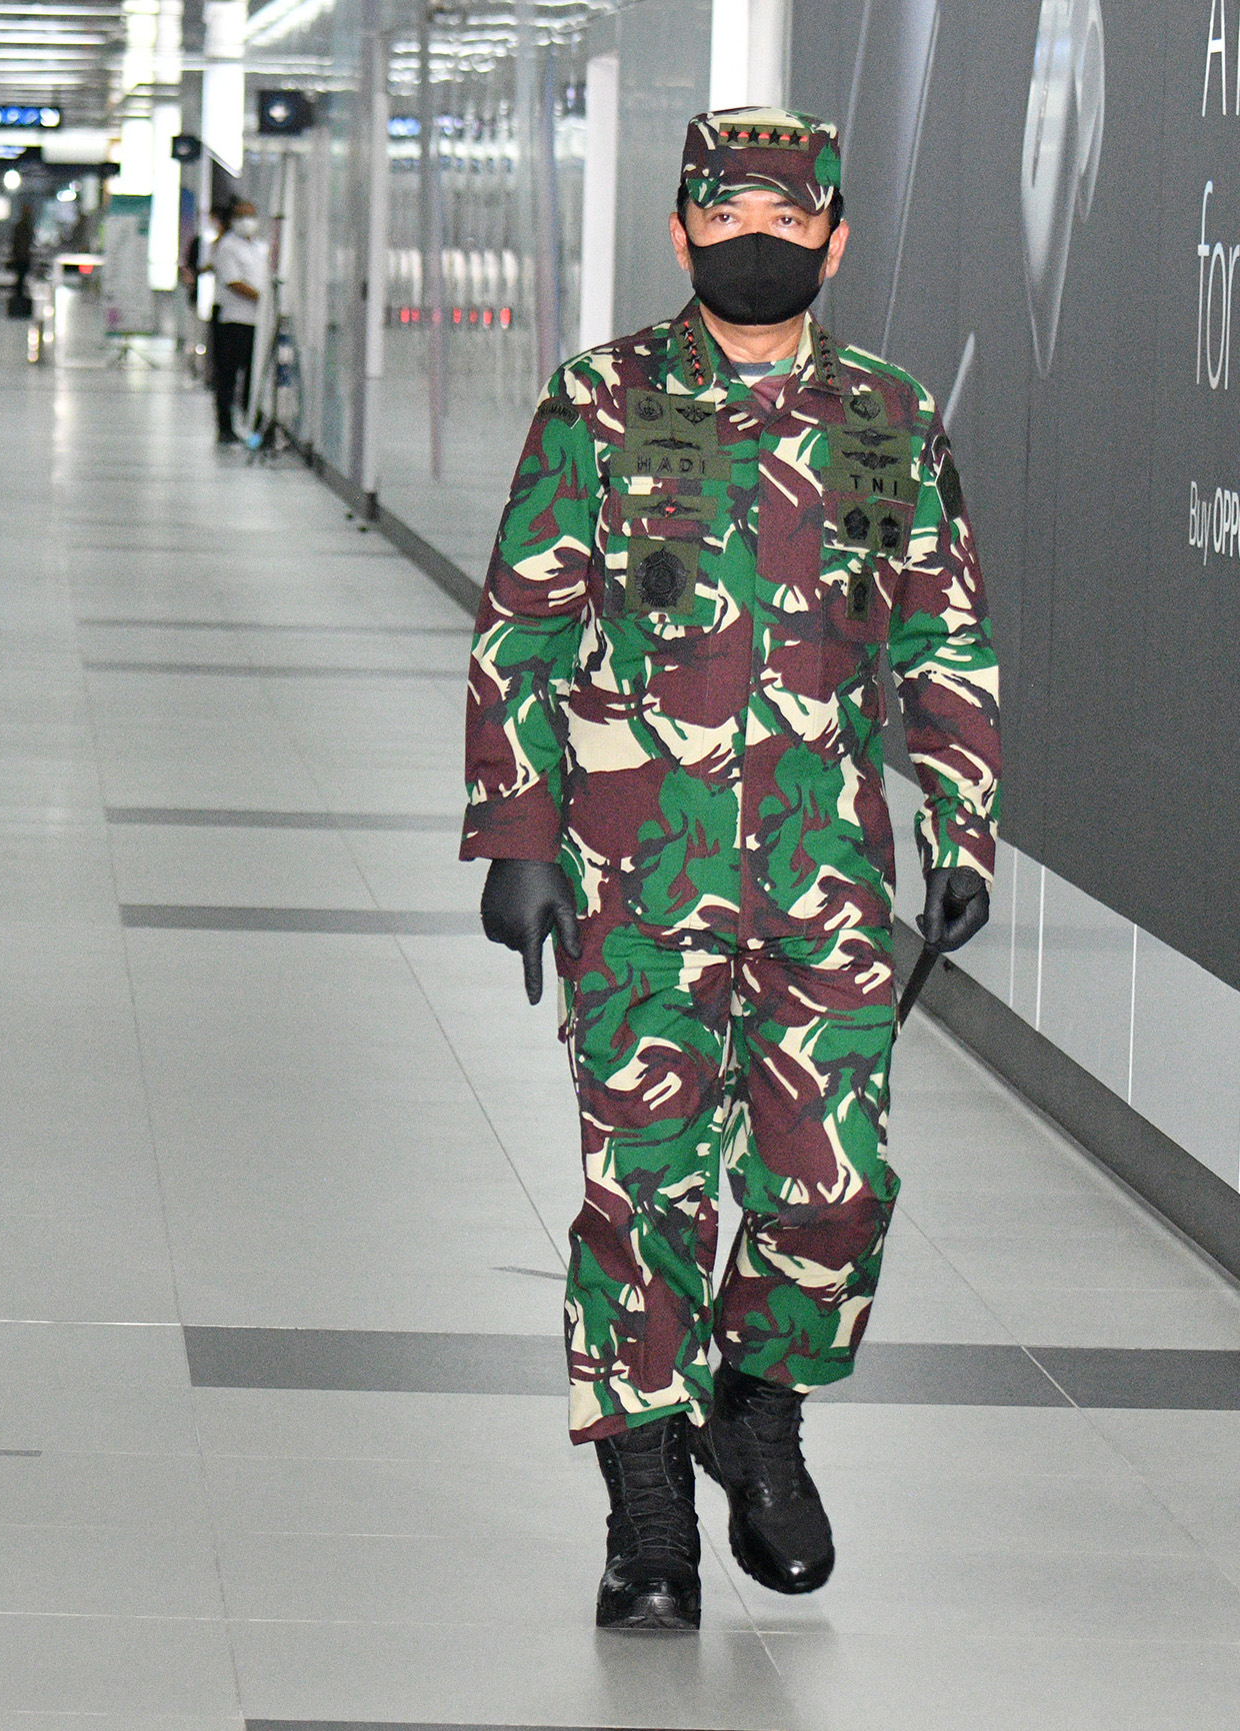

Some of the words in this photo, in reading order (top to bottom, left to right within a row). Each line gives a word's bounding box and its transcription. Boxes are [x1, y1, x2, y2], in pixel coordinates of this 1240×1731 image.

[636, 456, 705, 475] HADI
[849, 473, 898, 497] TNI
[1188, 480, 1212, 567] Buy
[1213, 486, 1240, 558] OPP
